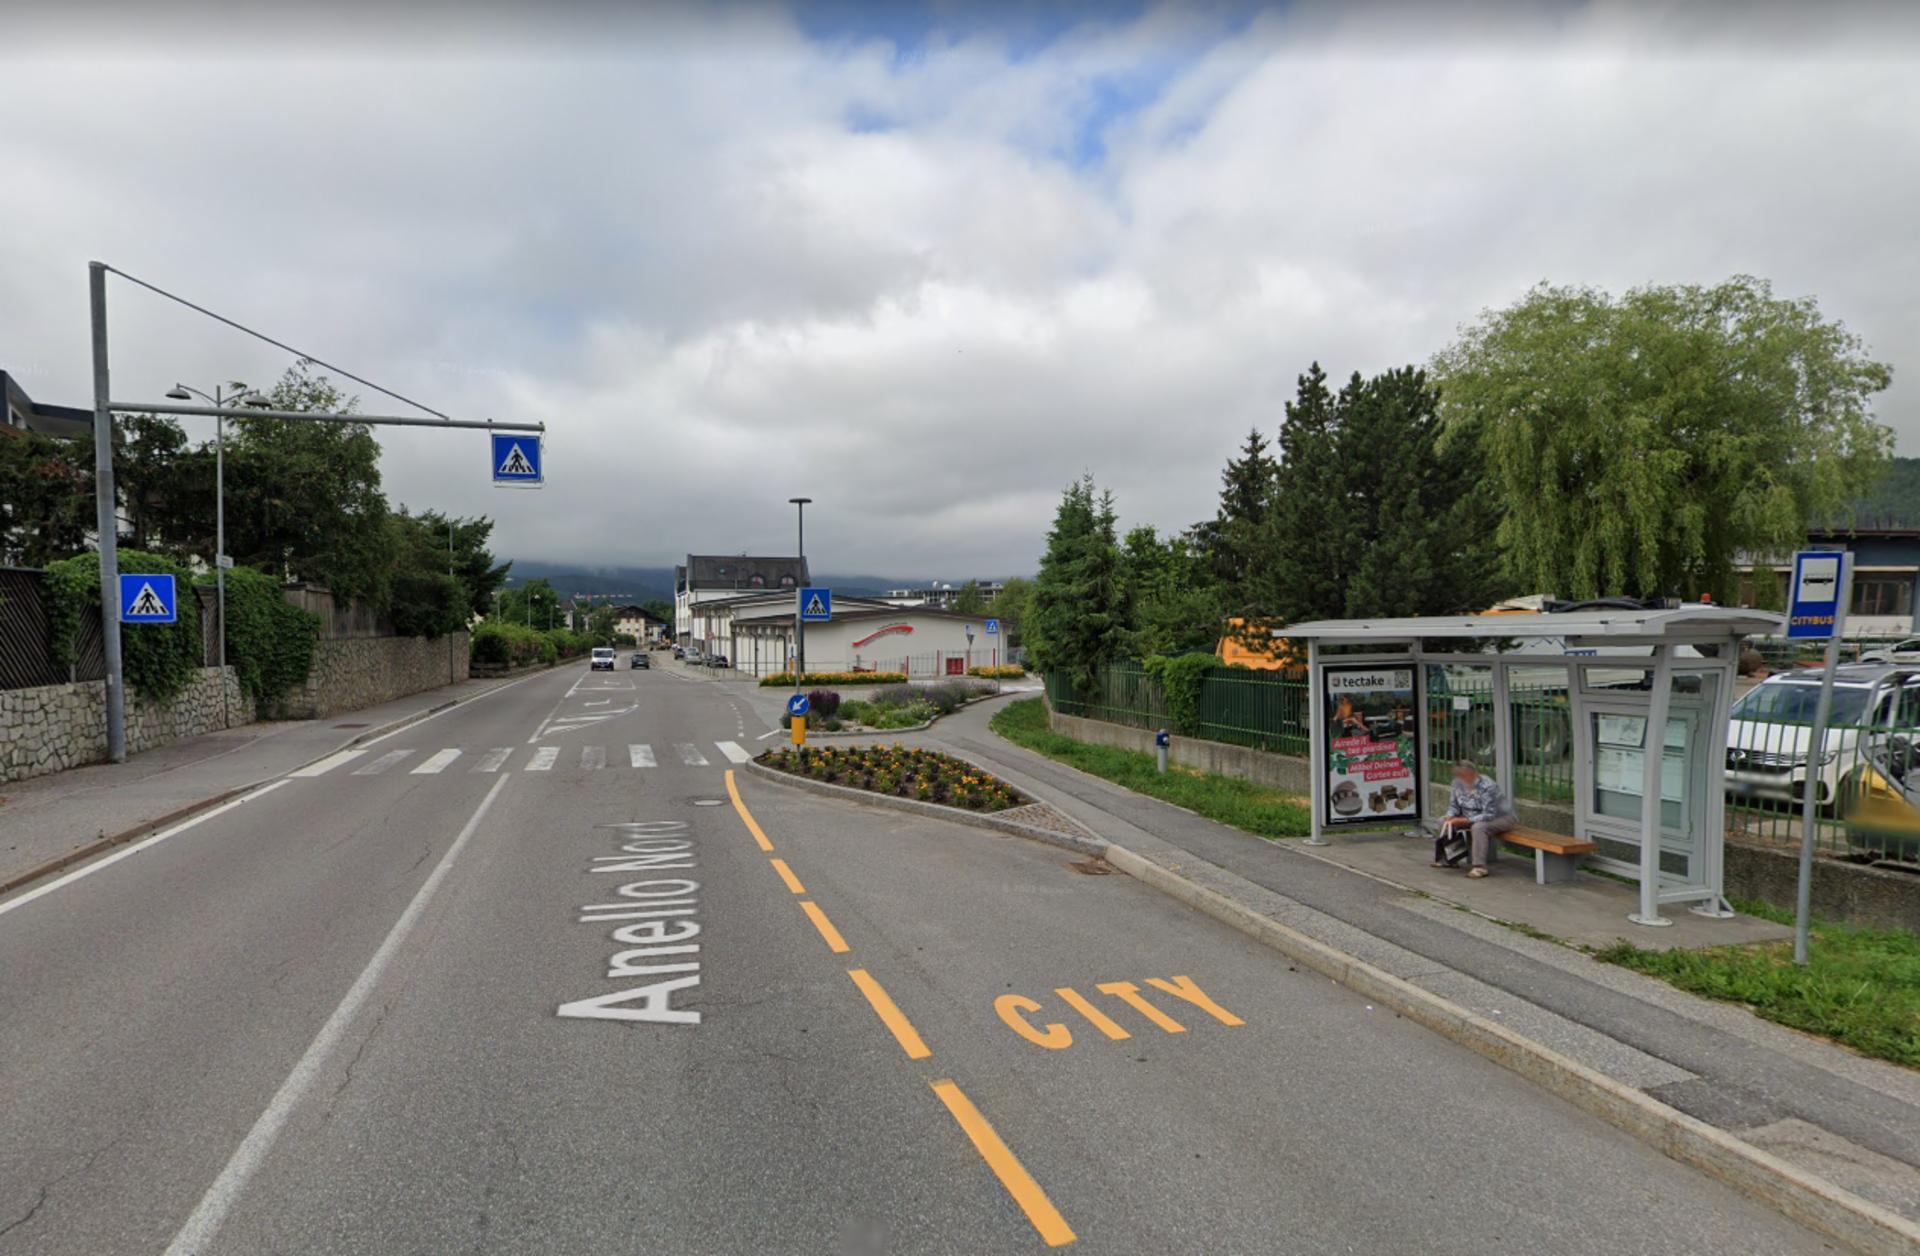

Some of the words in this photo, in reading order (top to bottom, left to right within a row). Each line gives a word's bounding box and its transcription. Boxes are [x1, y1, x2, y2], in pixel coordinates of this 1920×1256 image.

[1791, 616, 1835, 625] CITYBUS
[1343, 675, 1384, 687] tectake
[993, 975, 1245, 1050] CITY
